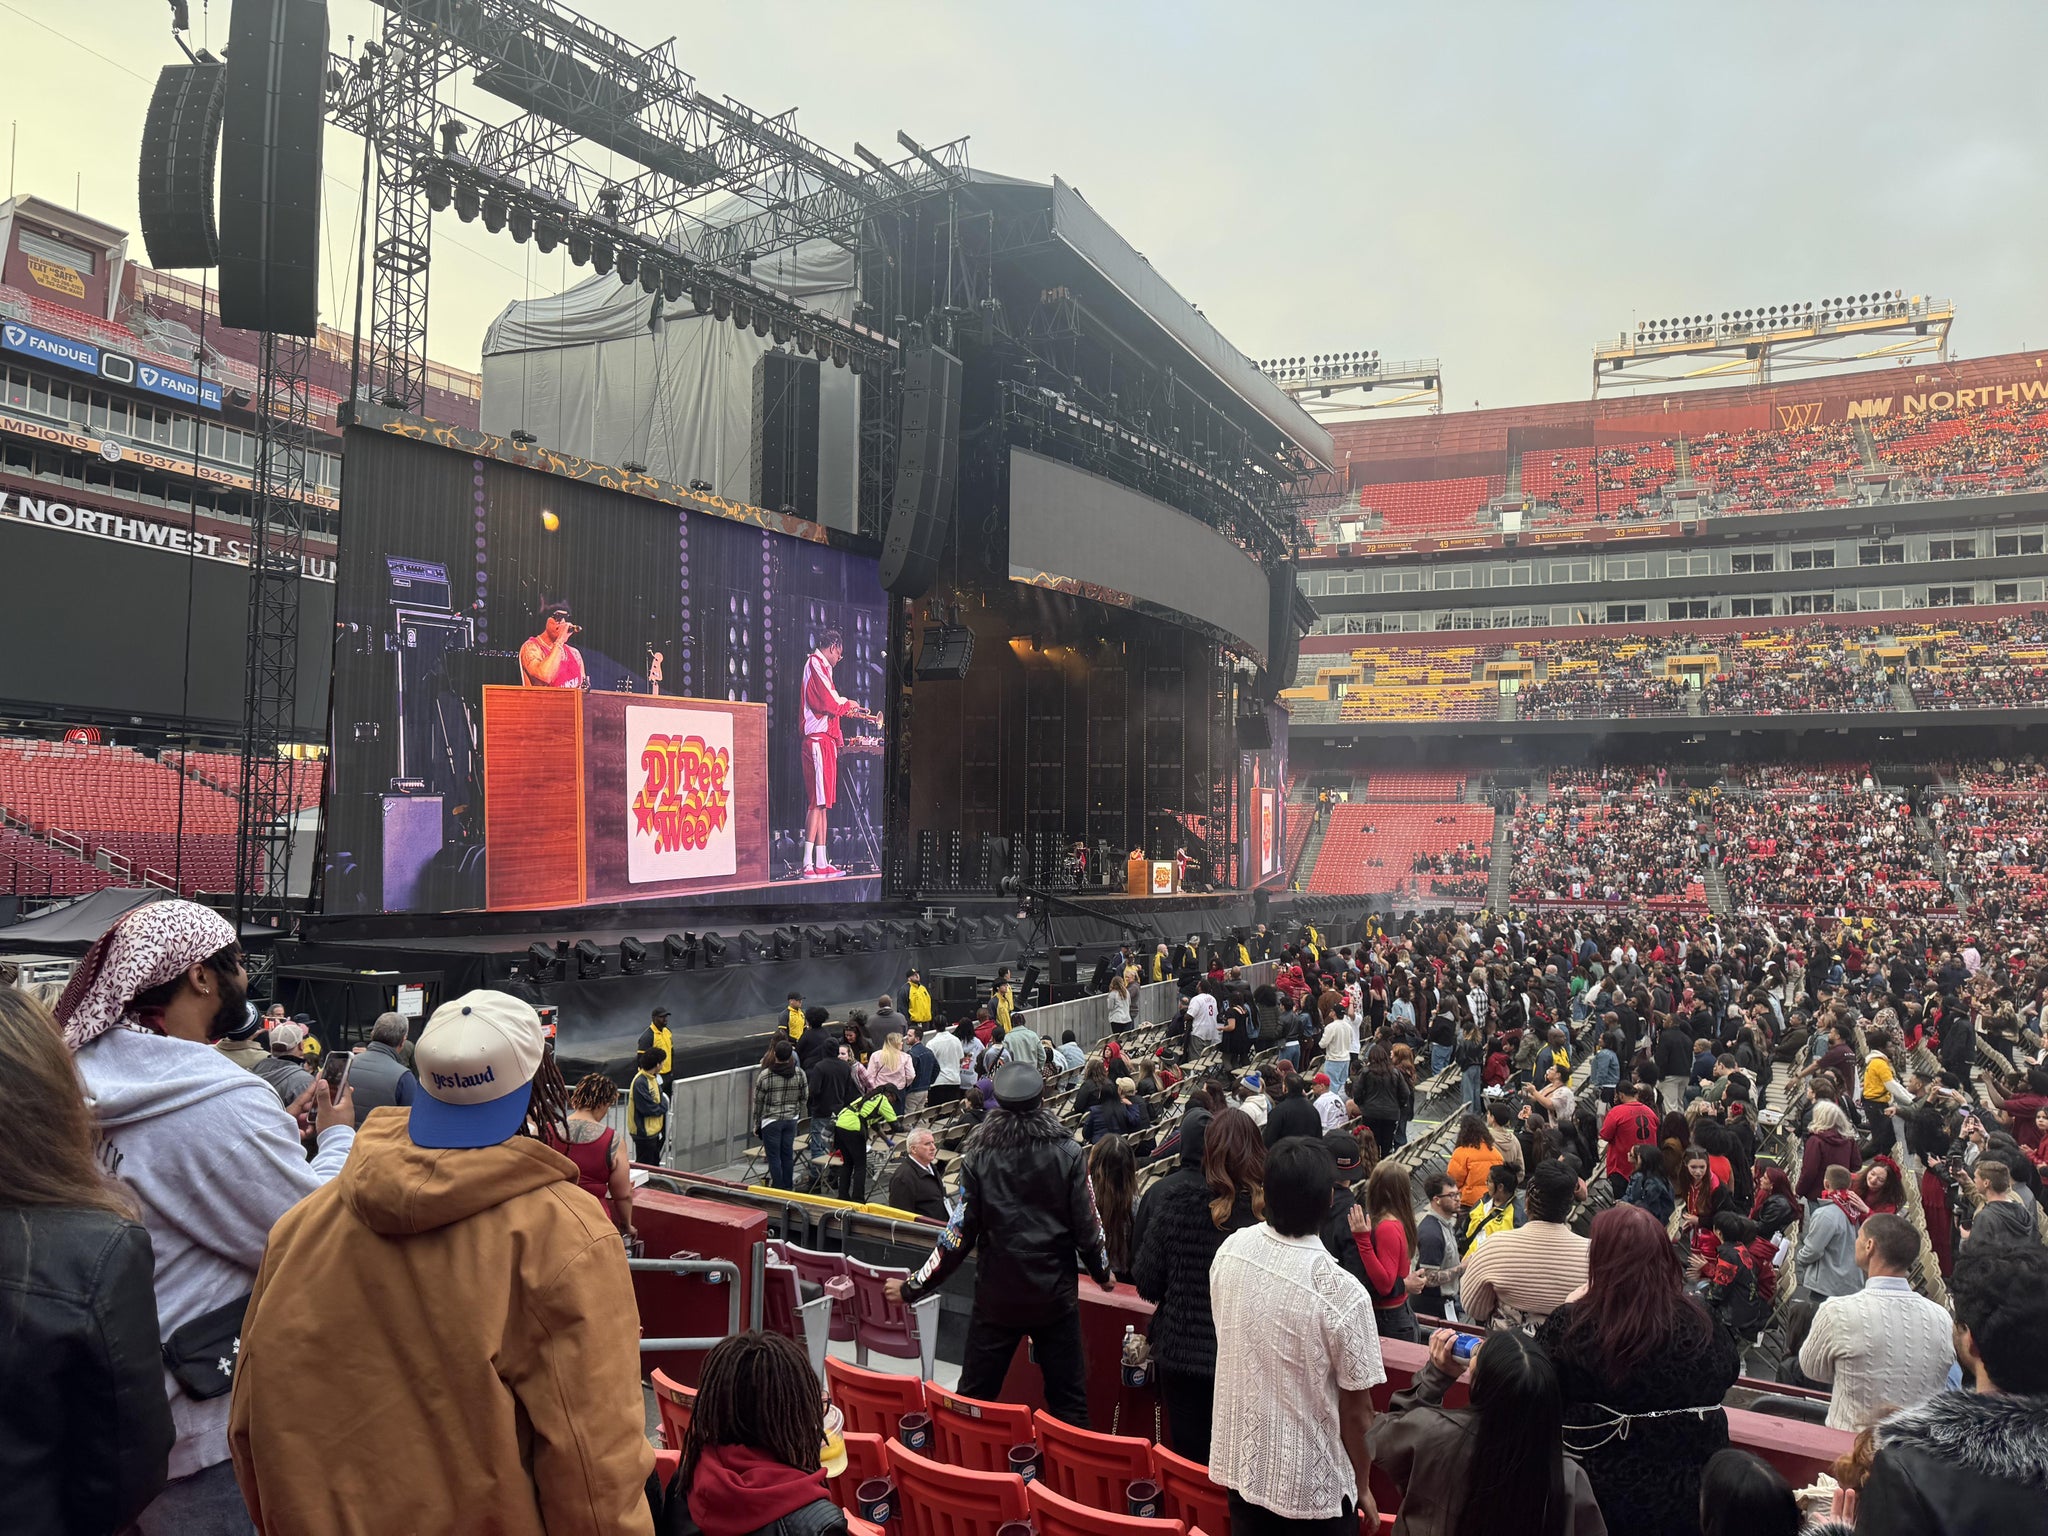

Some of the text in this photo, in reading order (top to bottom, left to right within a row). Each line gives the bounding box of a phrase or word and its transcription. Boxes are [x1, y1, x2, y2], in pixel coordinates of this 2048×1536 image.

[29, 261, 48, 273] TEXT
[29, 336, 96, 366] FANDUEL
[161, 377, 220, 403] FANDUEL
[1847, 397, 1892, 419] NW
[0, 418, 88, 448] MPIONS
[134, 452, 177, 469] 1937
[19, 496, 221, 556] NORTHWEST
[1615, 529, 1625, 537] 33
[1366, 544, 1376, 552] 72
[1439, 540, 1449, 548] 49
[1535, 534, 1541, 542] 9
[678, 736, 730, 792] Pee
[1208, 1004, 1214, 1017] 3
[1635, 1114, 1650, 1141] 8
